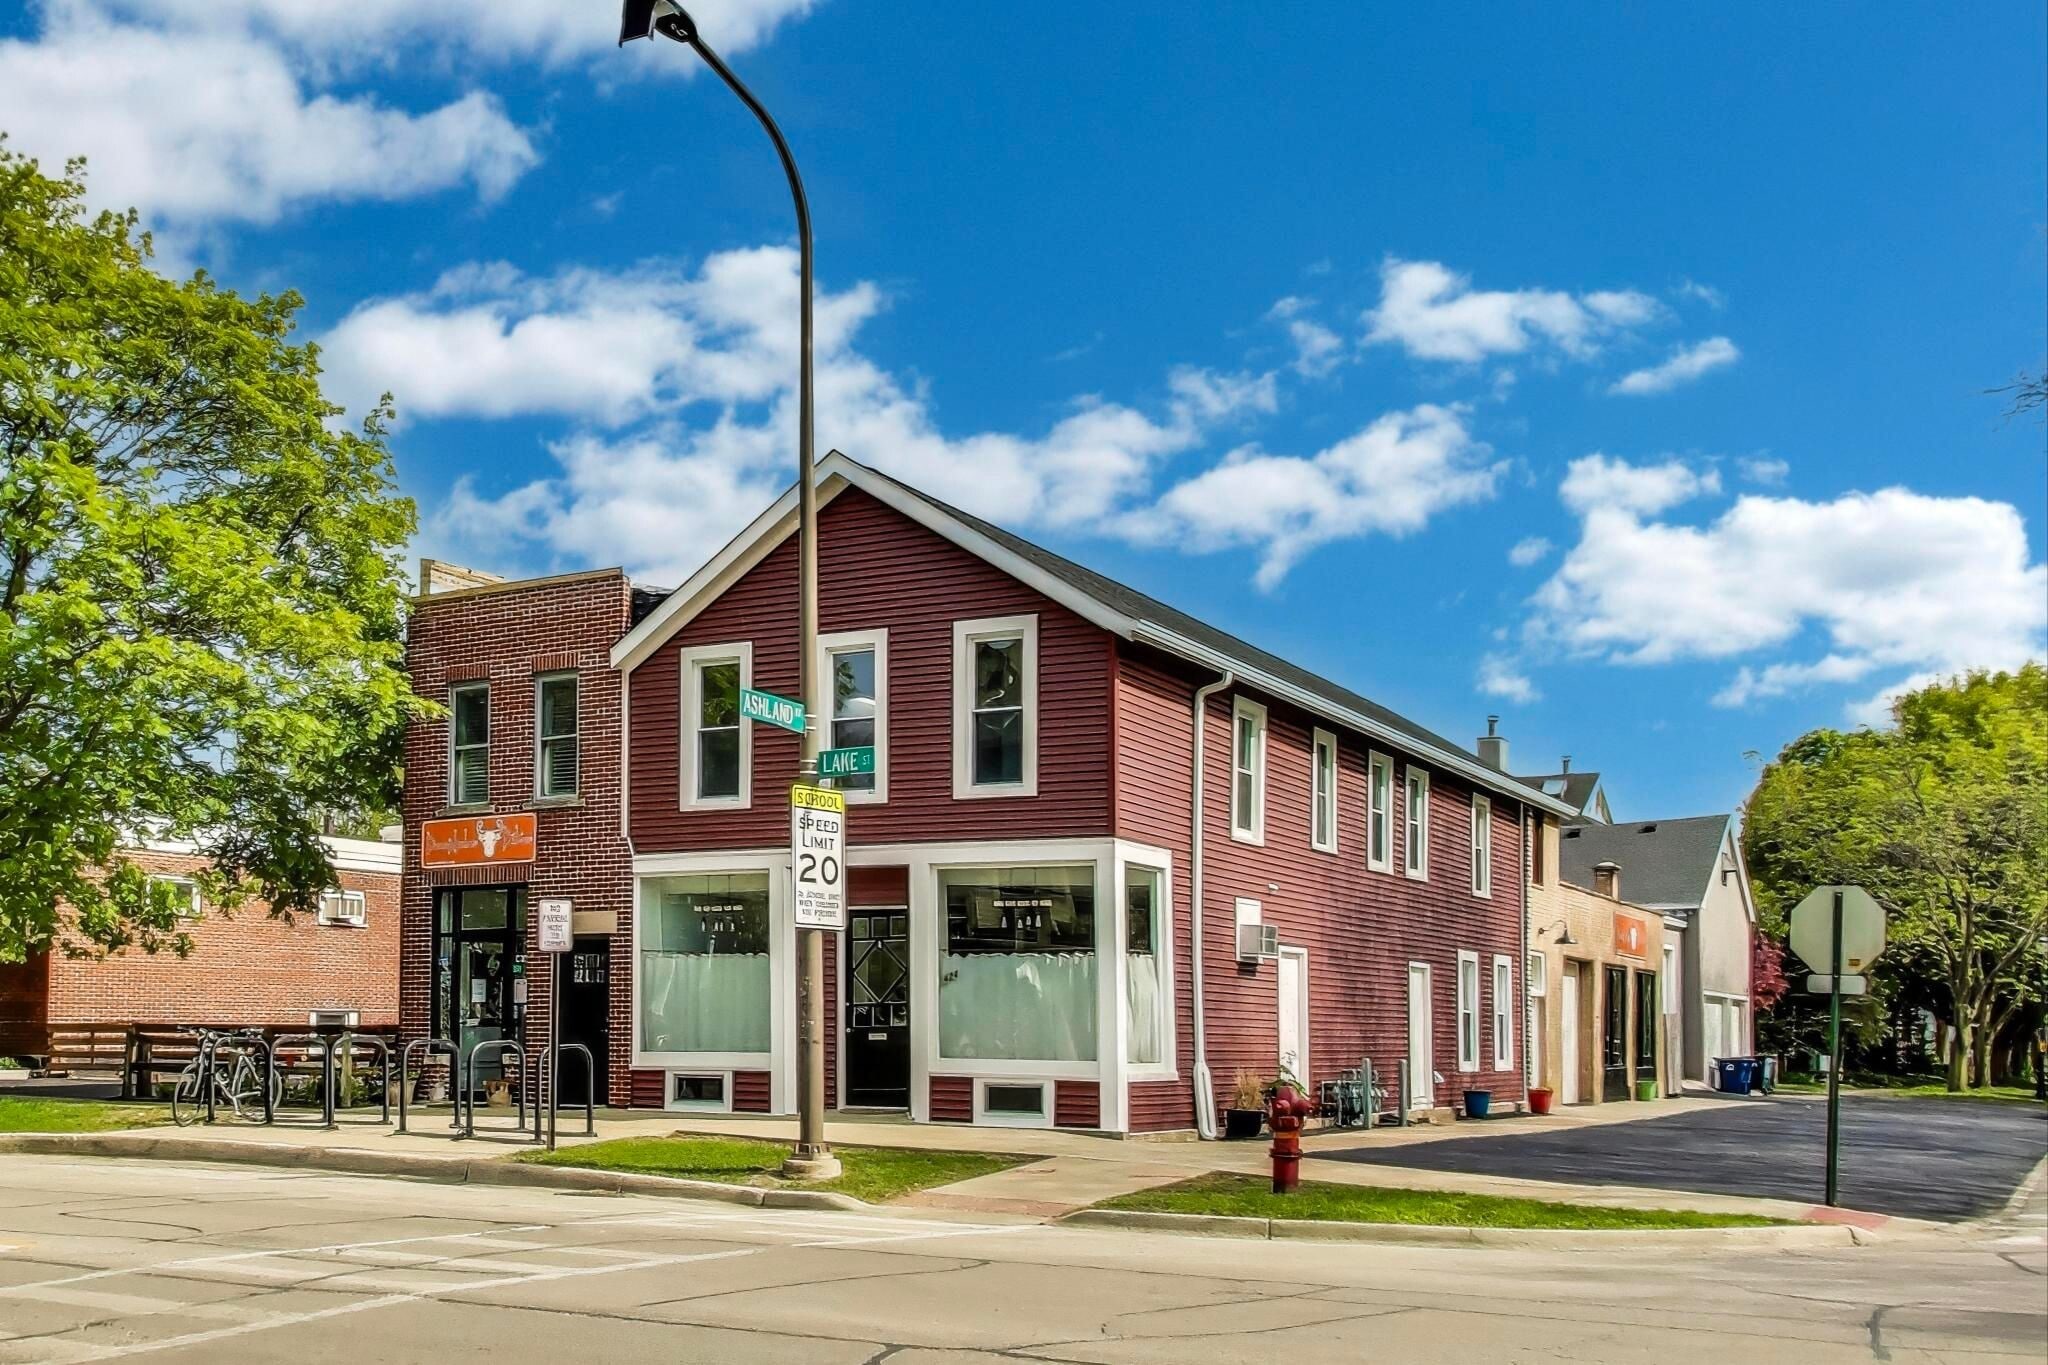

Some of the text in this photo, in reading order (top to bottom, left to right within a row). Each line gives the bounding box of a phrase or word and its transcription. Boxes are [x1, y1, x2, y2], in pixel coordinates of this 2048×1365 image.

[743, 692, 793, 724] ASHLAND
[823, 752, 858, 772] LAKE
[799, 815, 838, 833] SPEED
[802, 832, 834, 850] LIMIT
[799, 853, 838, 885] 20
